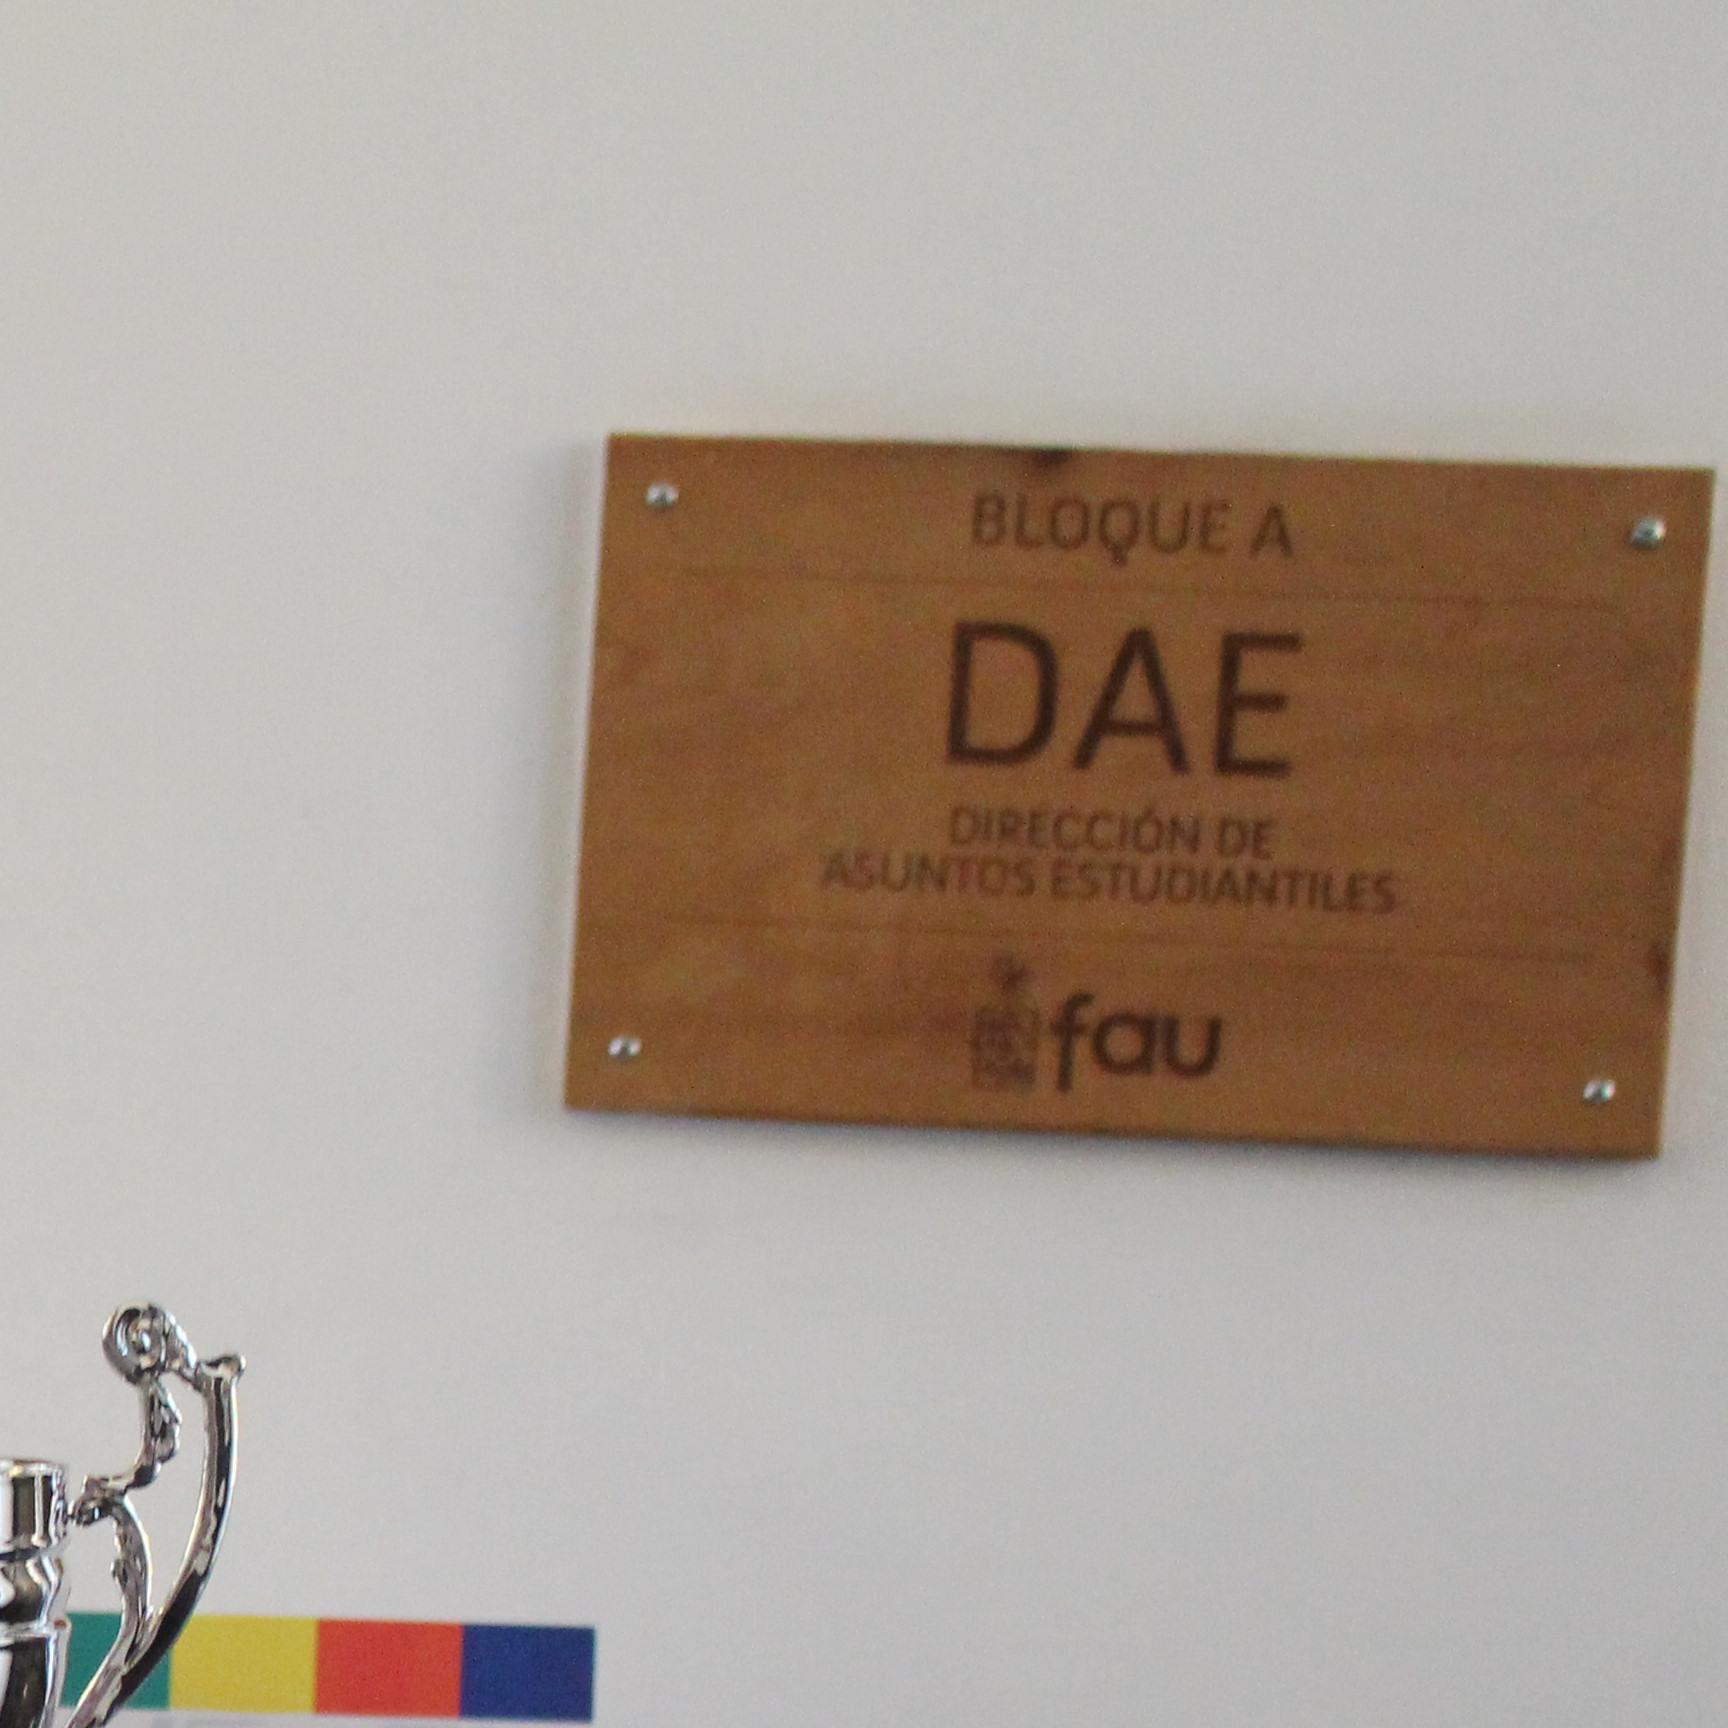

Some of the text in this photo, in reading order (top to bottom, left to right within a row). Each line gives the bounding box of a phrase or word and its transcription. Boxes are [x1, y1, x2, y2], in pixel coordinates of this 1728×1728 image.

[971, 492, 1294, 567] BLOQUE A
[948, 619, 1305, 779] DAE
[948, 804, 1277, 861] DIRECCIÓN DE
[821, 849, 1399, 915] ASUNTOS ESTUDIANTILES
[1048, 989, 1223, 1093] fau
